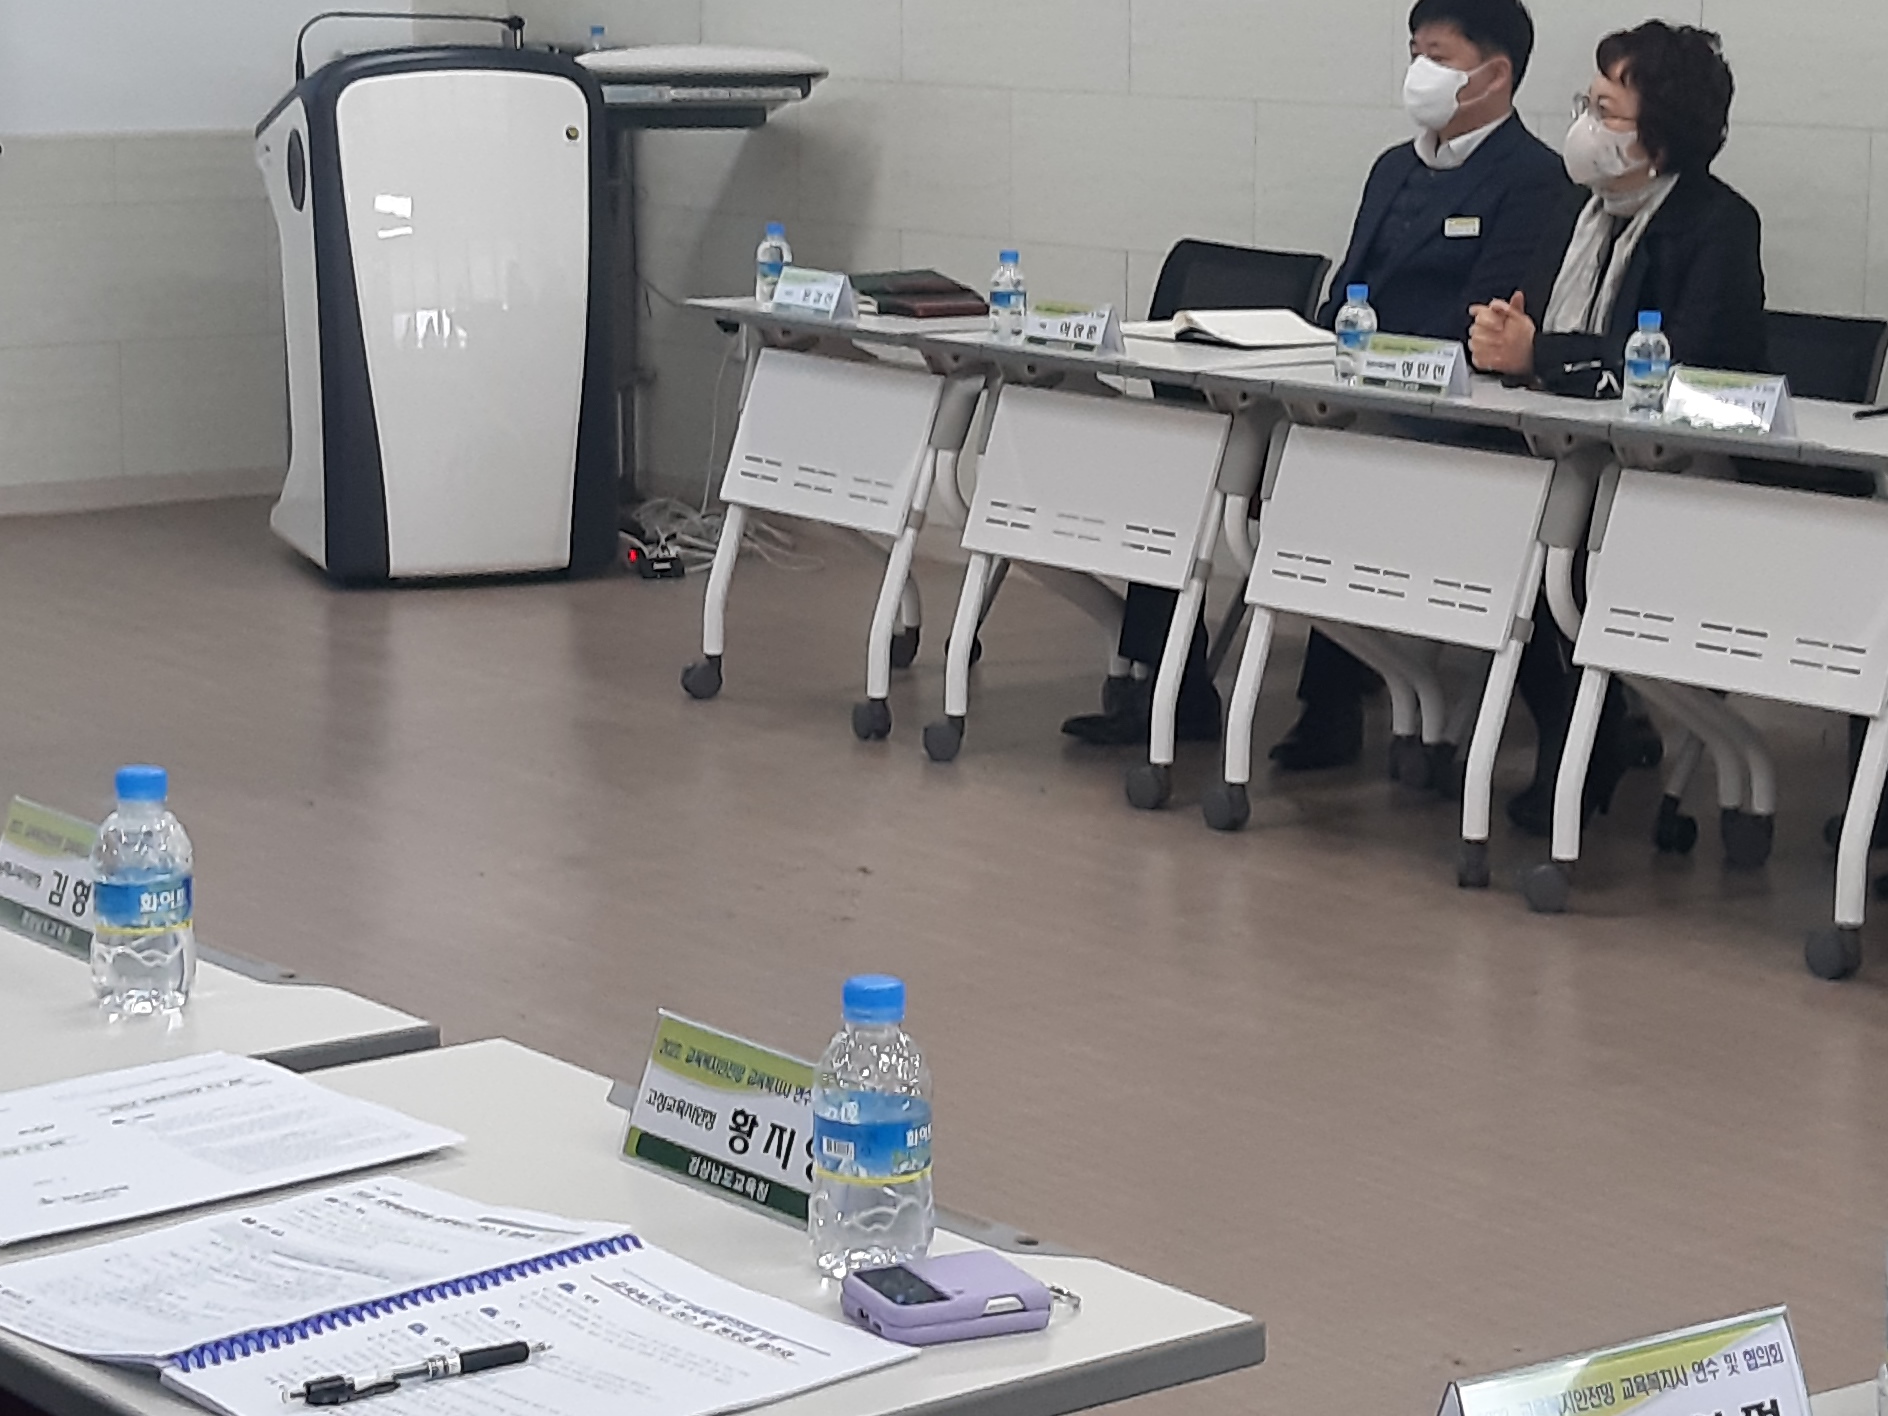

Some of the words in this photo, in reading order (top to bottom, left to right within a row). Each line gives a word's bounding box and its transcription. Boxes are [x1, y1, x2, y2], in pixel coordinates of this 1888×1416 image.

[728, 1107, 814, 1184] 황지
[1691, 1357, 1721, 1385] 연수
[1723, 1351, 1741, 1377] 및
[1742, 1341, 1785, 1372] 협의회
